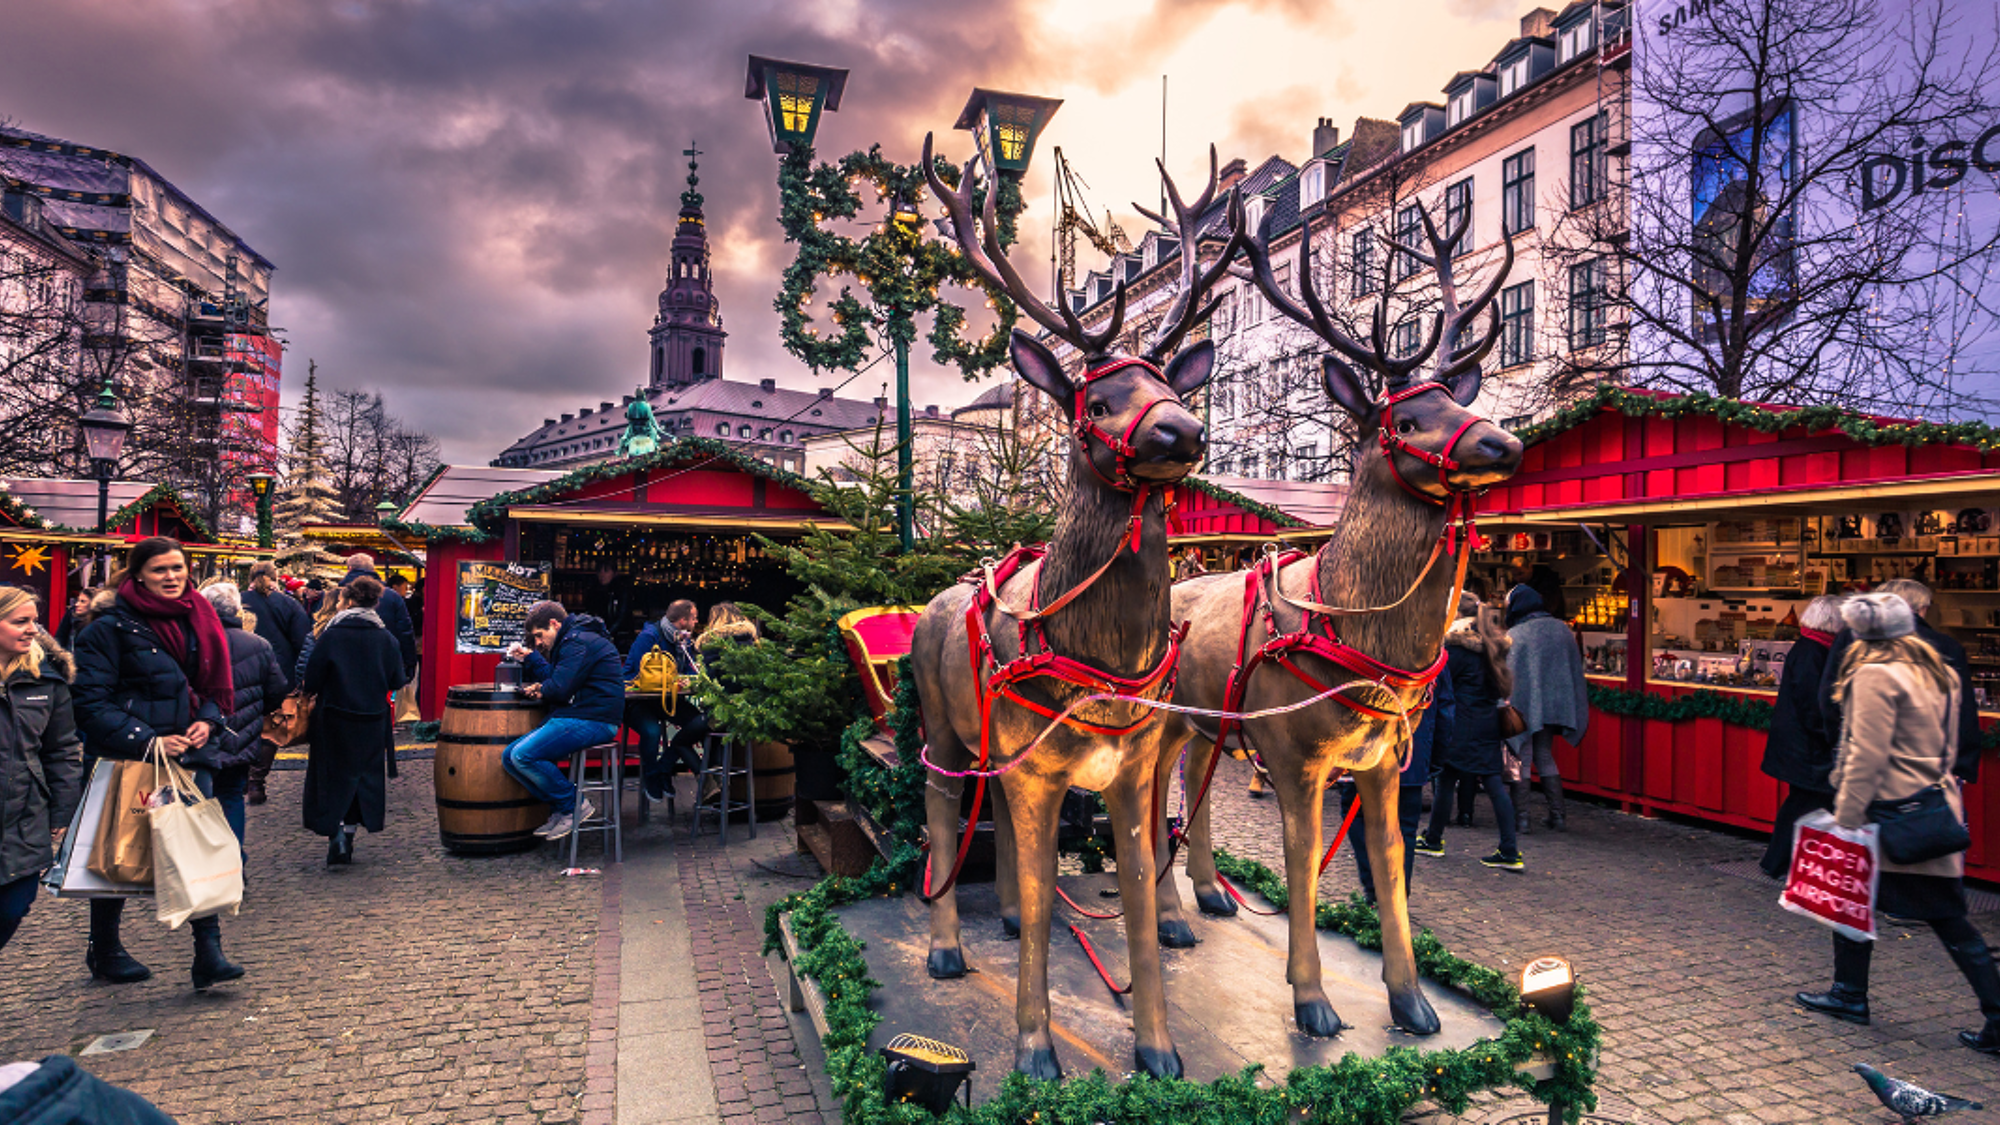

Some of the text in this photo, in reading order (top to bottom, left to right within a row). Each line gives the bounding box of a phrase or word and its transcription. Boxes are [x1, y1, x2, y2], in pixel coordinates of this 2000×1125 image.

[1802, 838, 1870, 873] COPEN
[1797, 857, 1870, 895] HAGEN
[1792, 880, 1869, 920] AIRPORT
